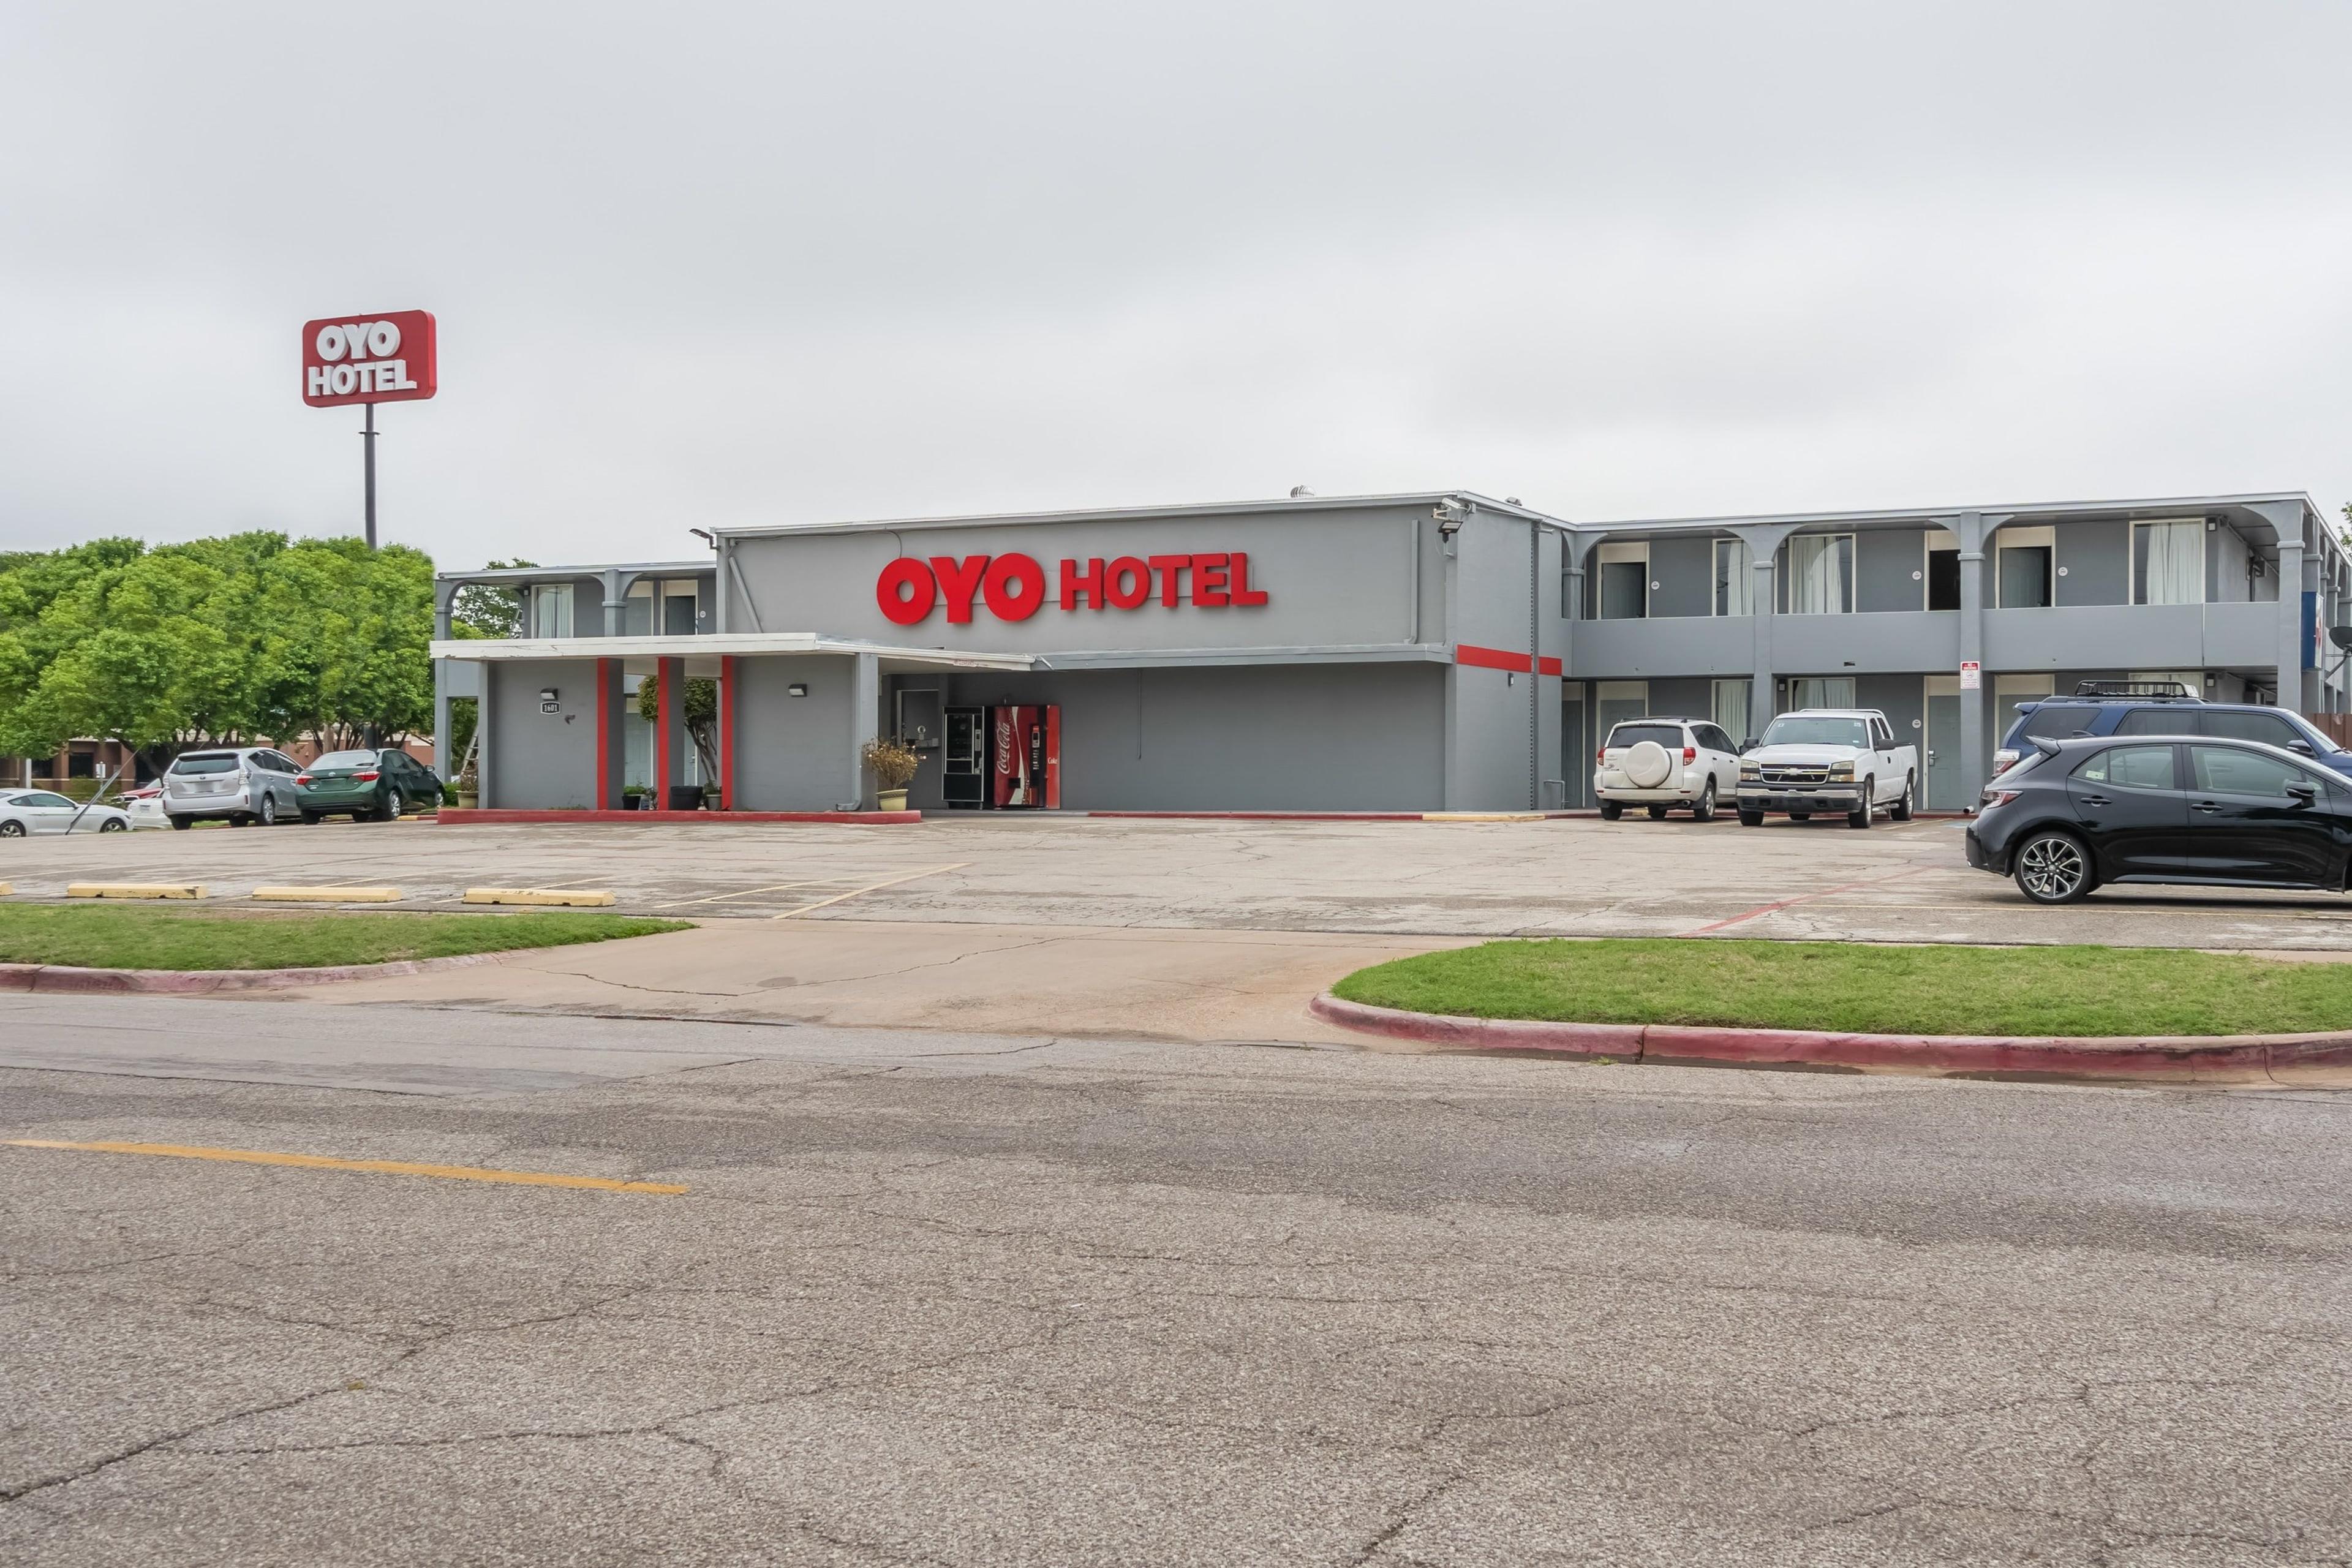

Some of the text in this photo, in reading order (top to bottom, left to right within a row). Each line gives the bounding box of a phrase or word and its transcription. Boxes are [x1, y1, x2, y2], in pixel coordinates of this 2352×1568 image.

[316, 320, 401, 361] OYO
[308, 359, 417, 396] HOTEL
[876, 552, 1268, 625] OYO HOTEL
